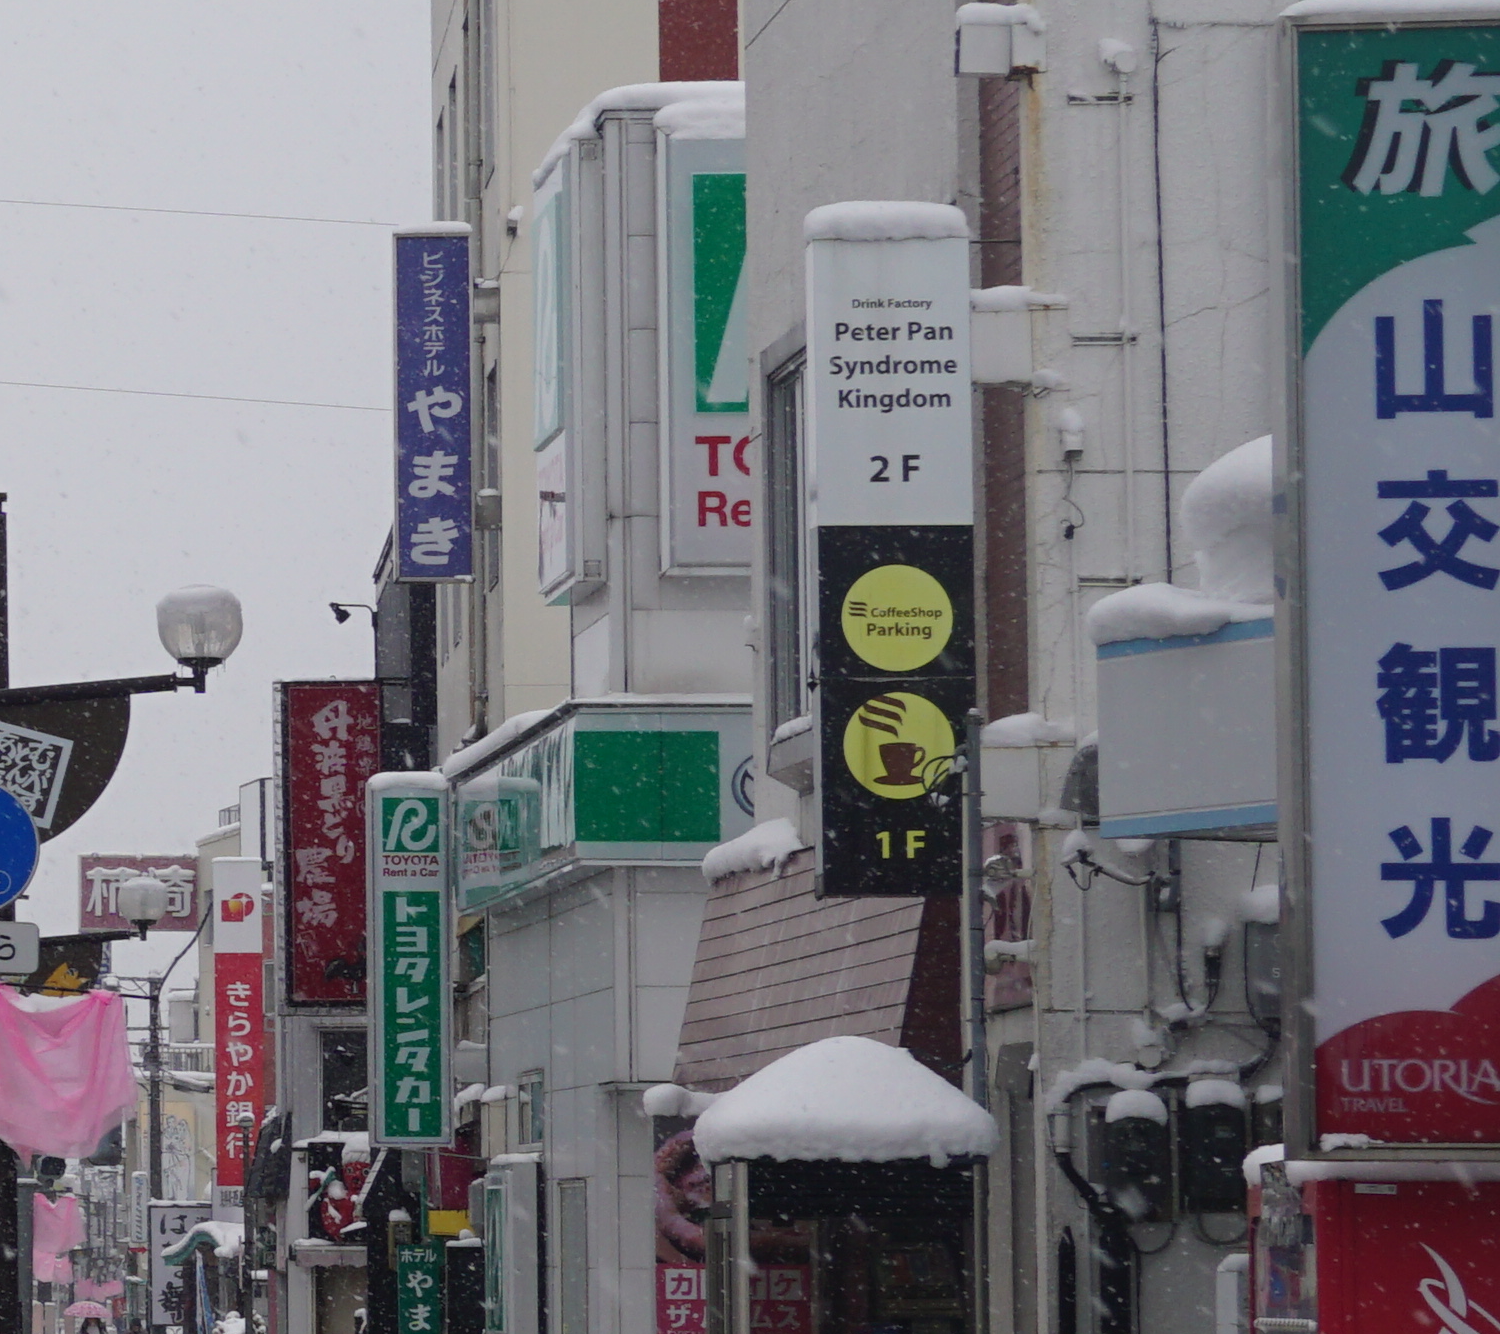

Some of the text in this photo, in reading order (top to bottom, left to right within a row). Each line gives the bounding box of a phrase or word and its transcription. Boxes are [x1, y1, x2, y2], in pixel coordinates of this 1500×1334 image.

[422, 251, 444, 378] ビジネスホテル
[851, 298, 932, 311] Drink Factory
[835, 322, 953, 342] Peter Pan
[830, 355, 958, 380] Syndrome
[838, 389, 952, 414] Kingdom
[408, 387, 463, 568] やまき
[870, 606, 943, 619] CoffeeShop
[1372, 297, 1500, 941] 山交観光
[866, 622, 933, 641] Parking
[876, 830, 927, 860] 1F
[382, 855, 440, 866] TOYOTA
[382, 868, 406, 878] Rent
[419, 867, 440, 878] Car
[391, 899, 433, 1132] トヨタレンタカー
[225, 980, 252, 1158] きらやか銀行
[1340, 1058, 1500, 1105] UTORIA
[1341, 1097, 1407, 1114] TRAVEL
[400, 1249, 437, 1264] ホテル
